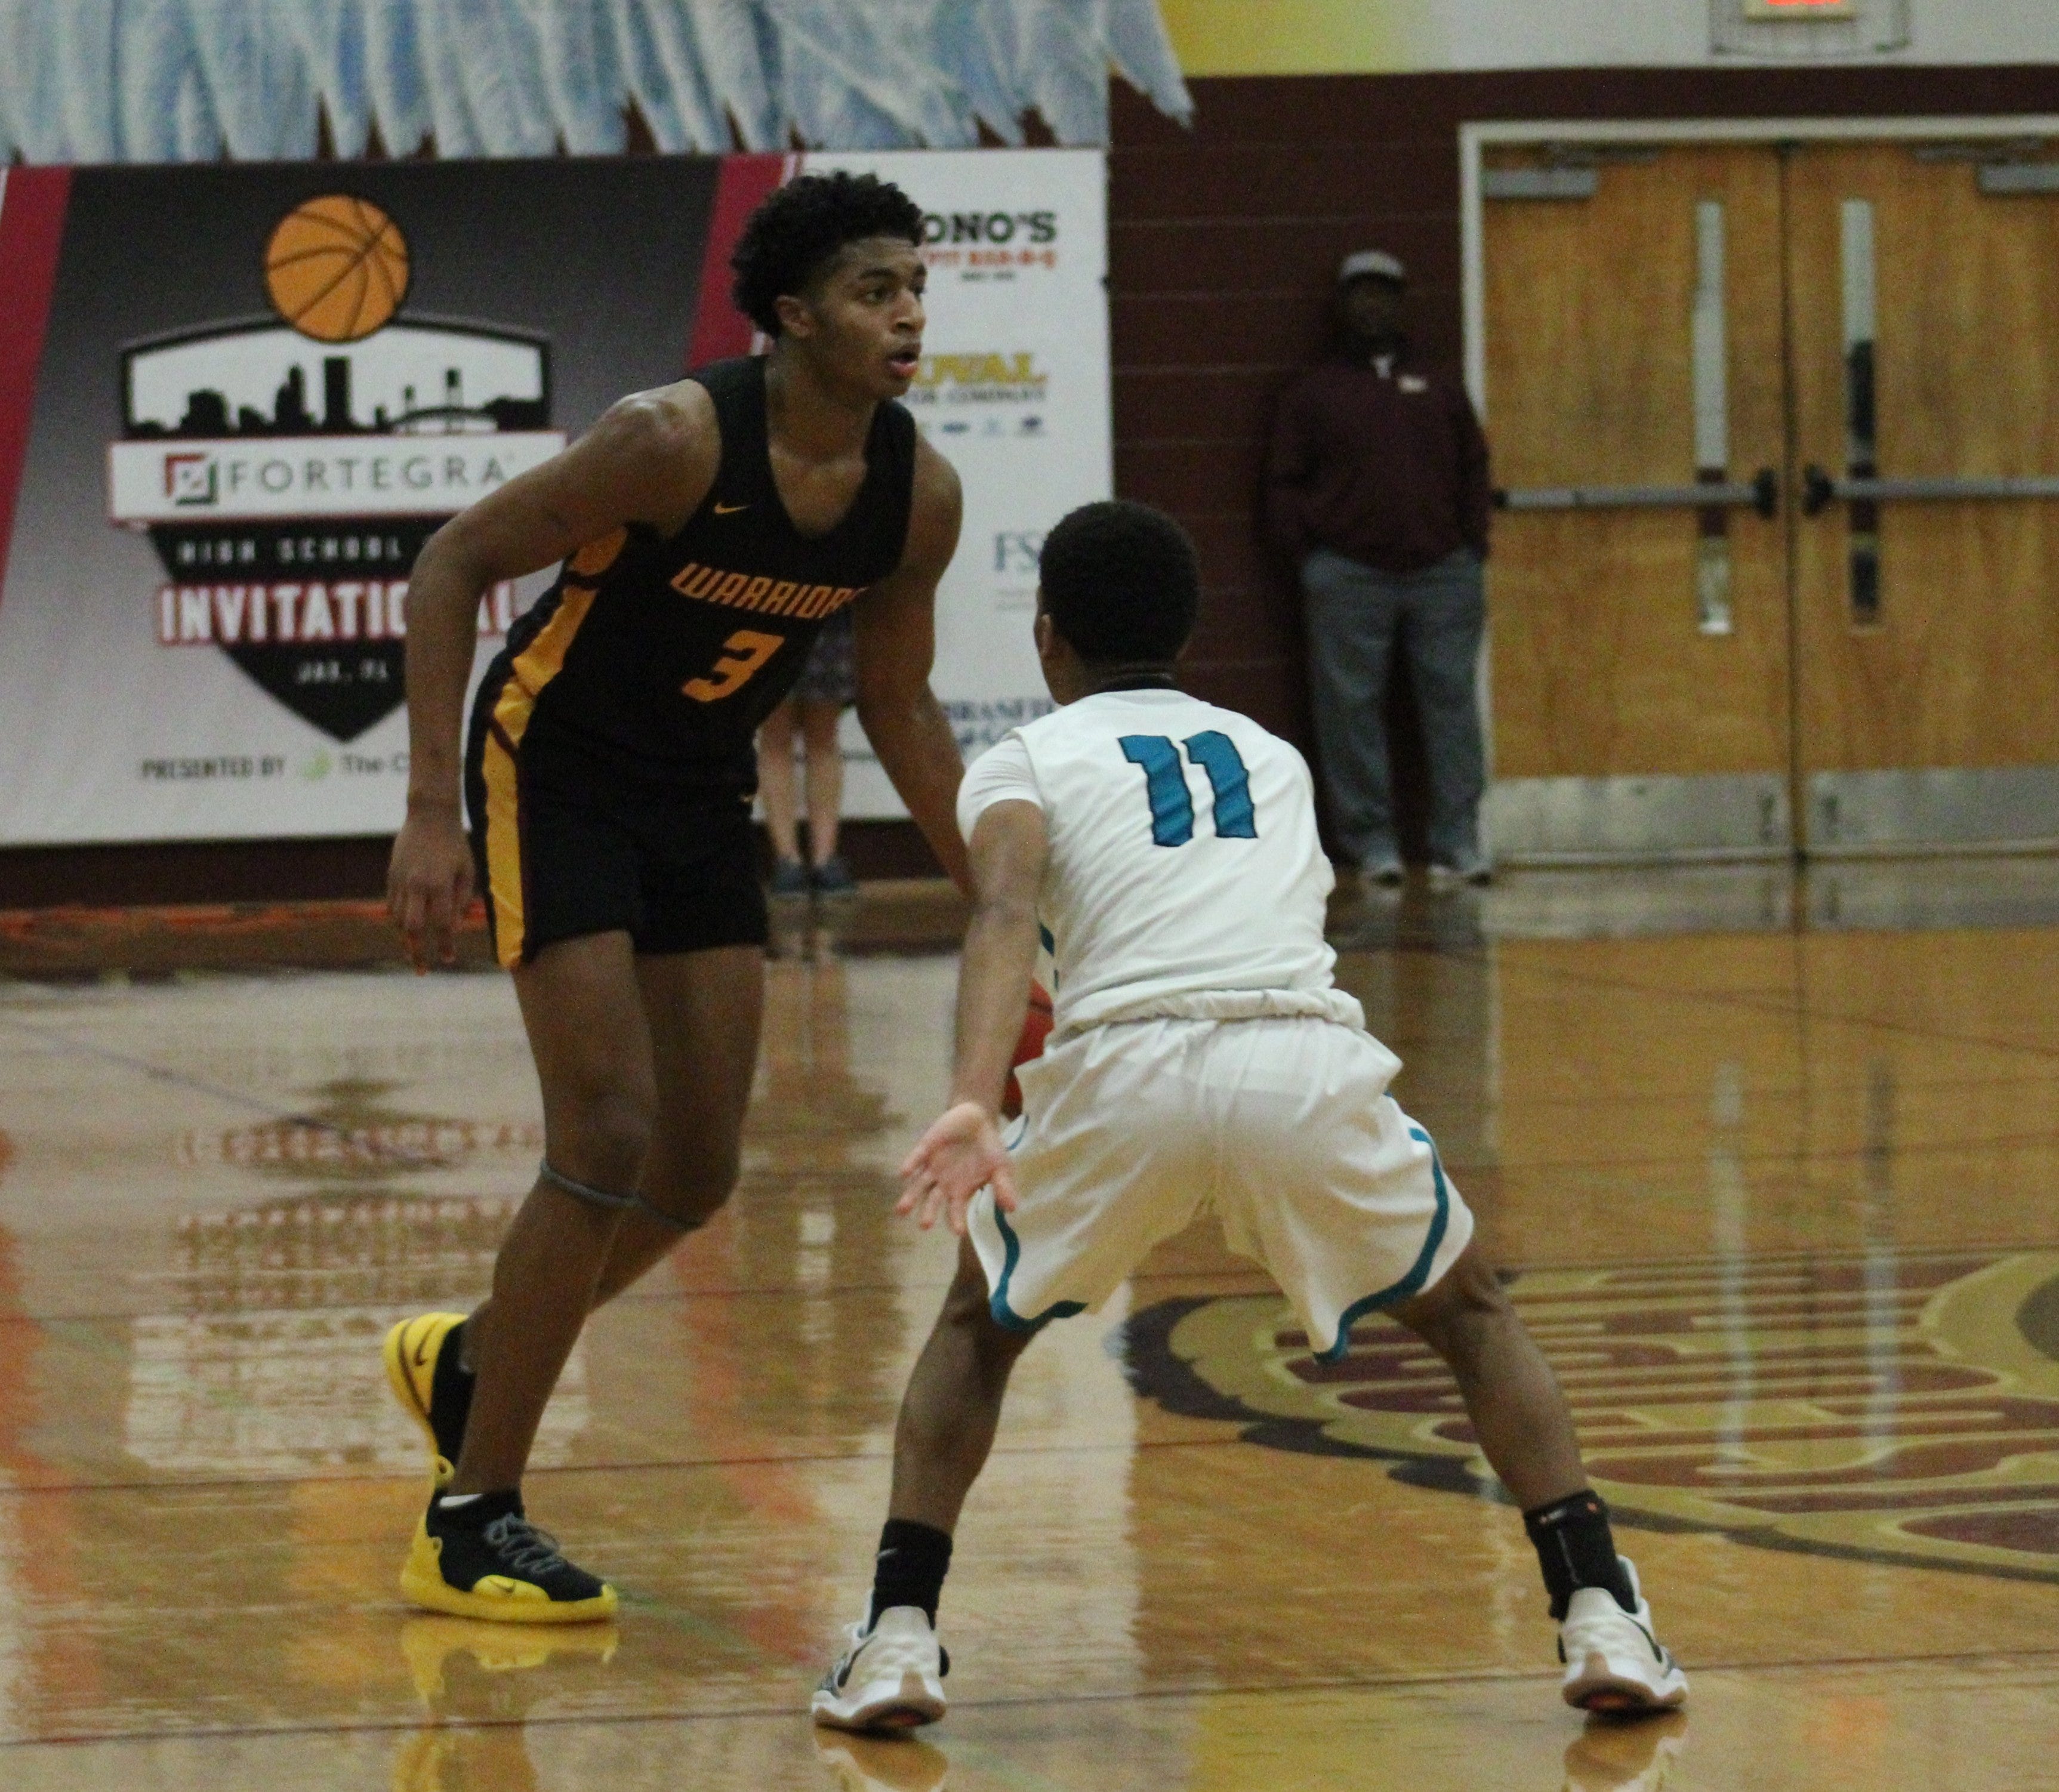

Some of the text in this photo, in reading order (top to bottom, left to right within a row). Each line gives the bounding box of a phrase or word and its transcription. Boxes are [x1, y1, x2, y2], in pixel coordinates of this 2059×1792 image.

[922, 211, 1056, 243] ONO'S
[226, 456, 505, 493] FORTEGRA
[277, 535, 403, 562] SCHOOL
[670, 562, 869, 619] WARRIOR
[682, 630, 786, 702] 3
[141, 755, 252, 779] PRESENTED
[260, 754, 286, 777] BY
[1117, 730, 1258, 847] 11
